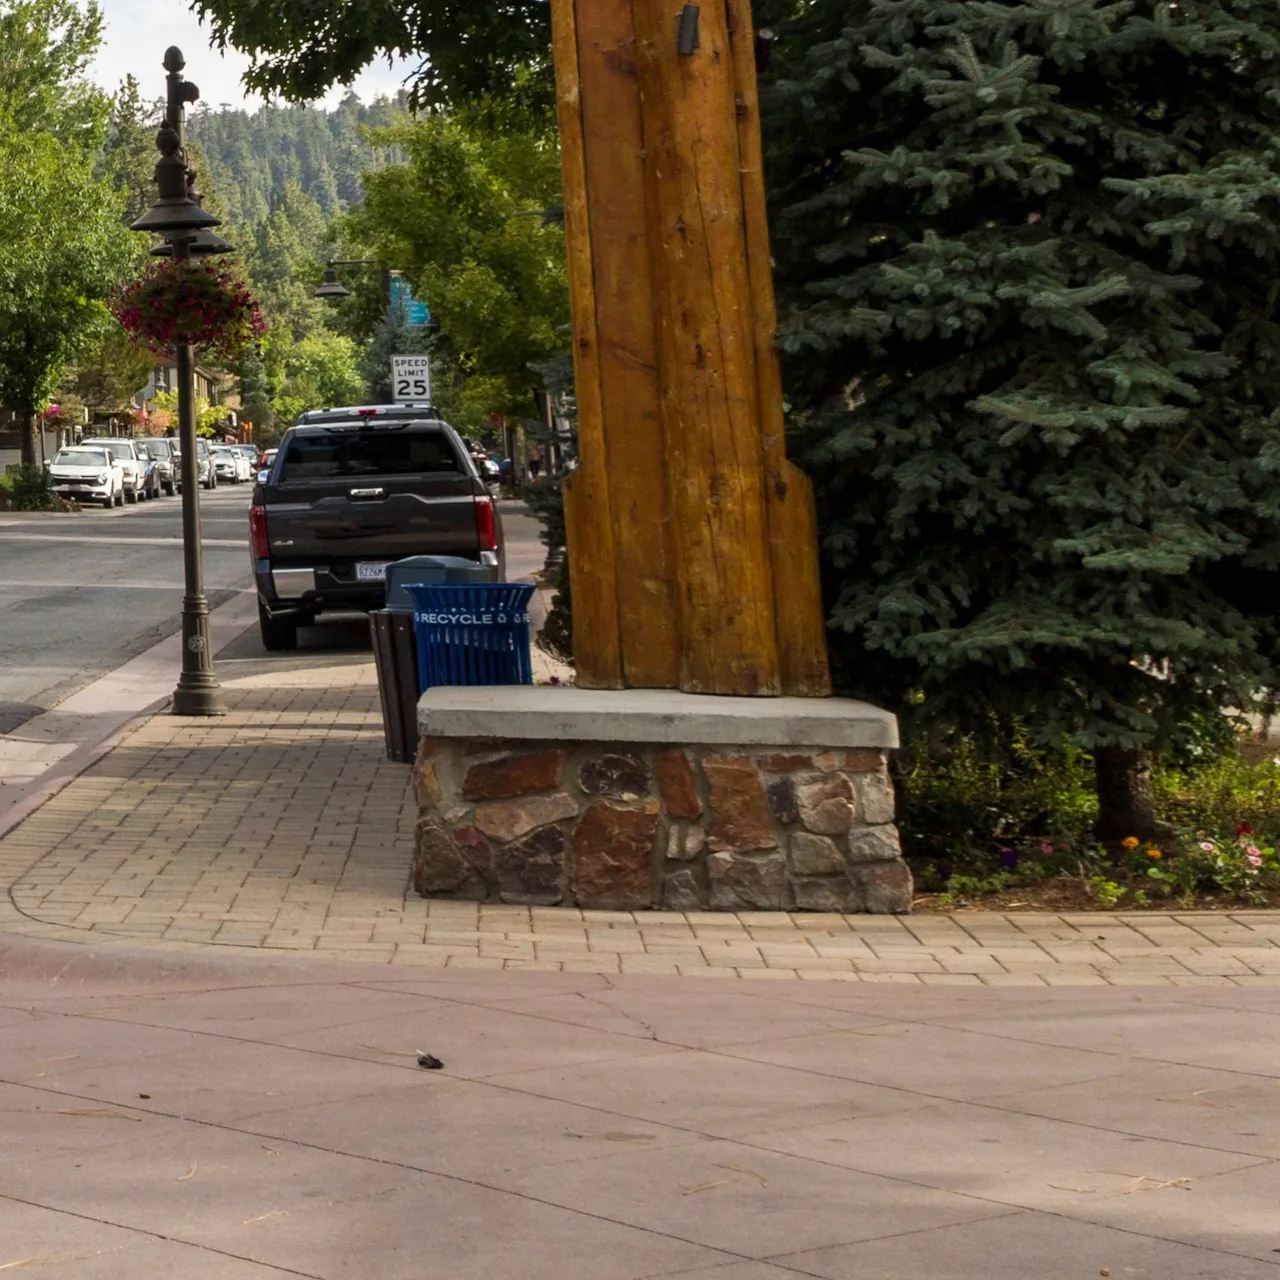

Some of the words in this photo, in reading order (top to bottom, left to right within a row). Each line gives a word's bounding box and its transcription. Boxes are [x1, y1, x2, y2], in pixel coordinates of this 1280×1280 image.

[394, 359, 428, 367] SPEED
[397, 369, 425, 377] LIMIT
[397, 380, 427, 396] 25
[421, 612, 493, 625] RECYCLE
